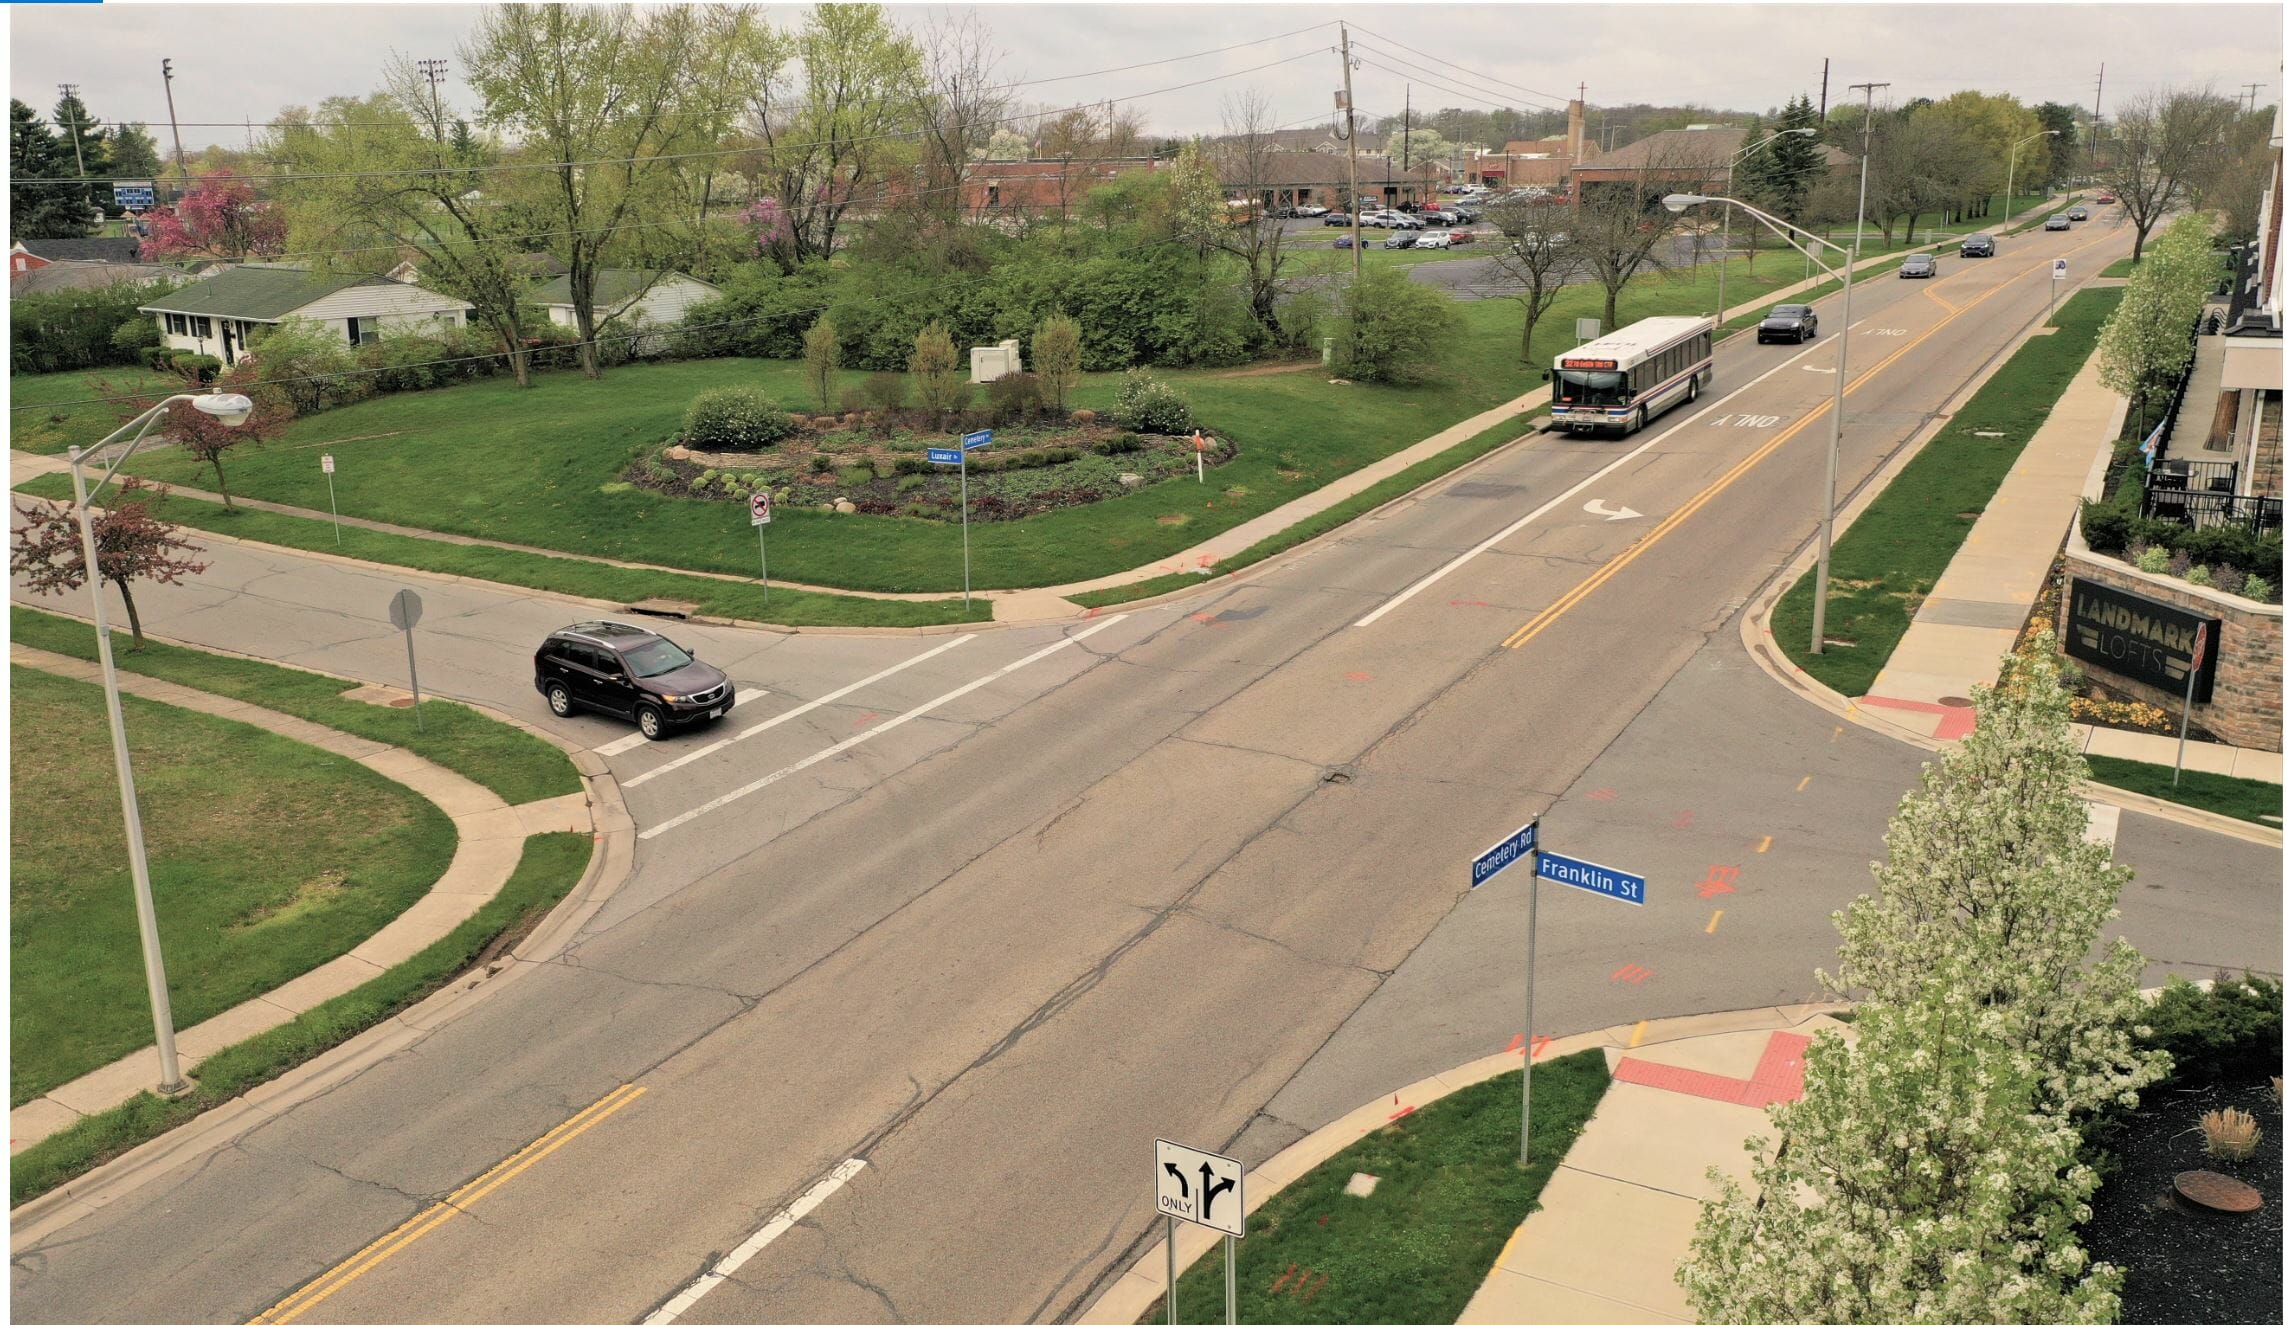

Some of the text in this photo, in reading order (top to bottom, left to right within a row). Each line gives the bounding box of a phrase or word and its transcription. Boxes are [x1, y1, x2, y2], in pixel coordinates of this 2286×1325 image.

[1709, 414, 1780, 428] ONLY
[965, 435, 985, 446] Cemetery
[931, 451, 952, 461] Luxair
[2078, 593, 2197, 655] LANDMARK
[2100, 631, 2162, 673] LOFTS
[1475, 828, 1532, 878] Cemetery Rd
[1542, 859, 1637, 899] Franklin St
[1162, 1195, 1192, 1213] ONLY
